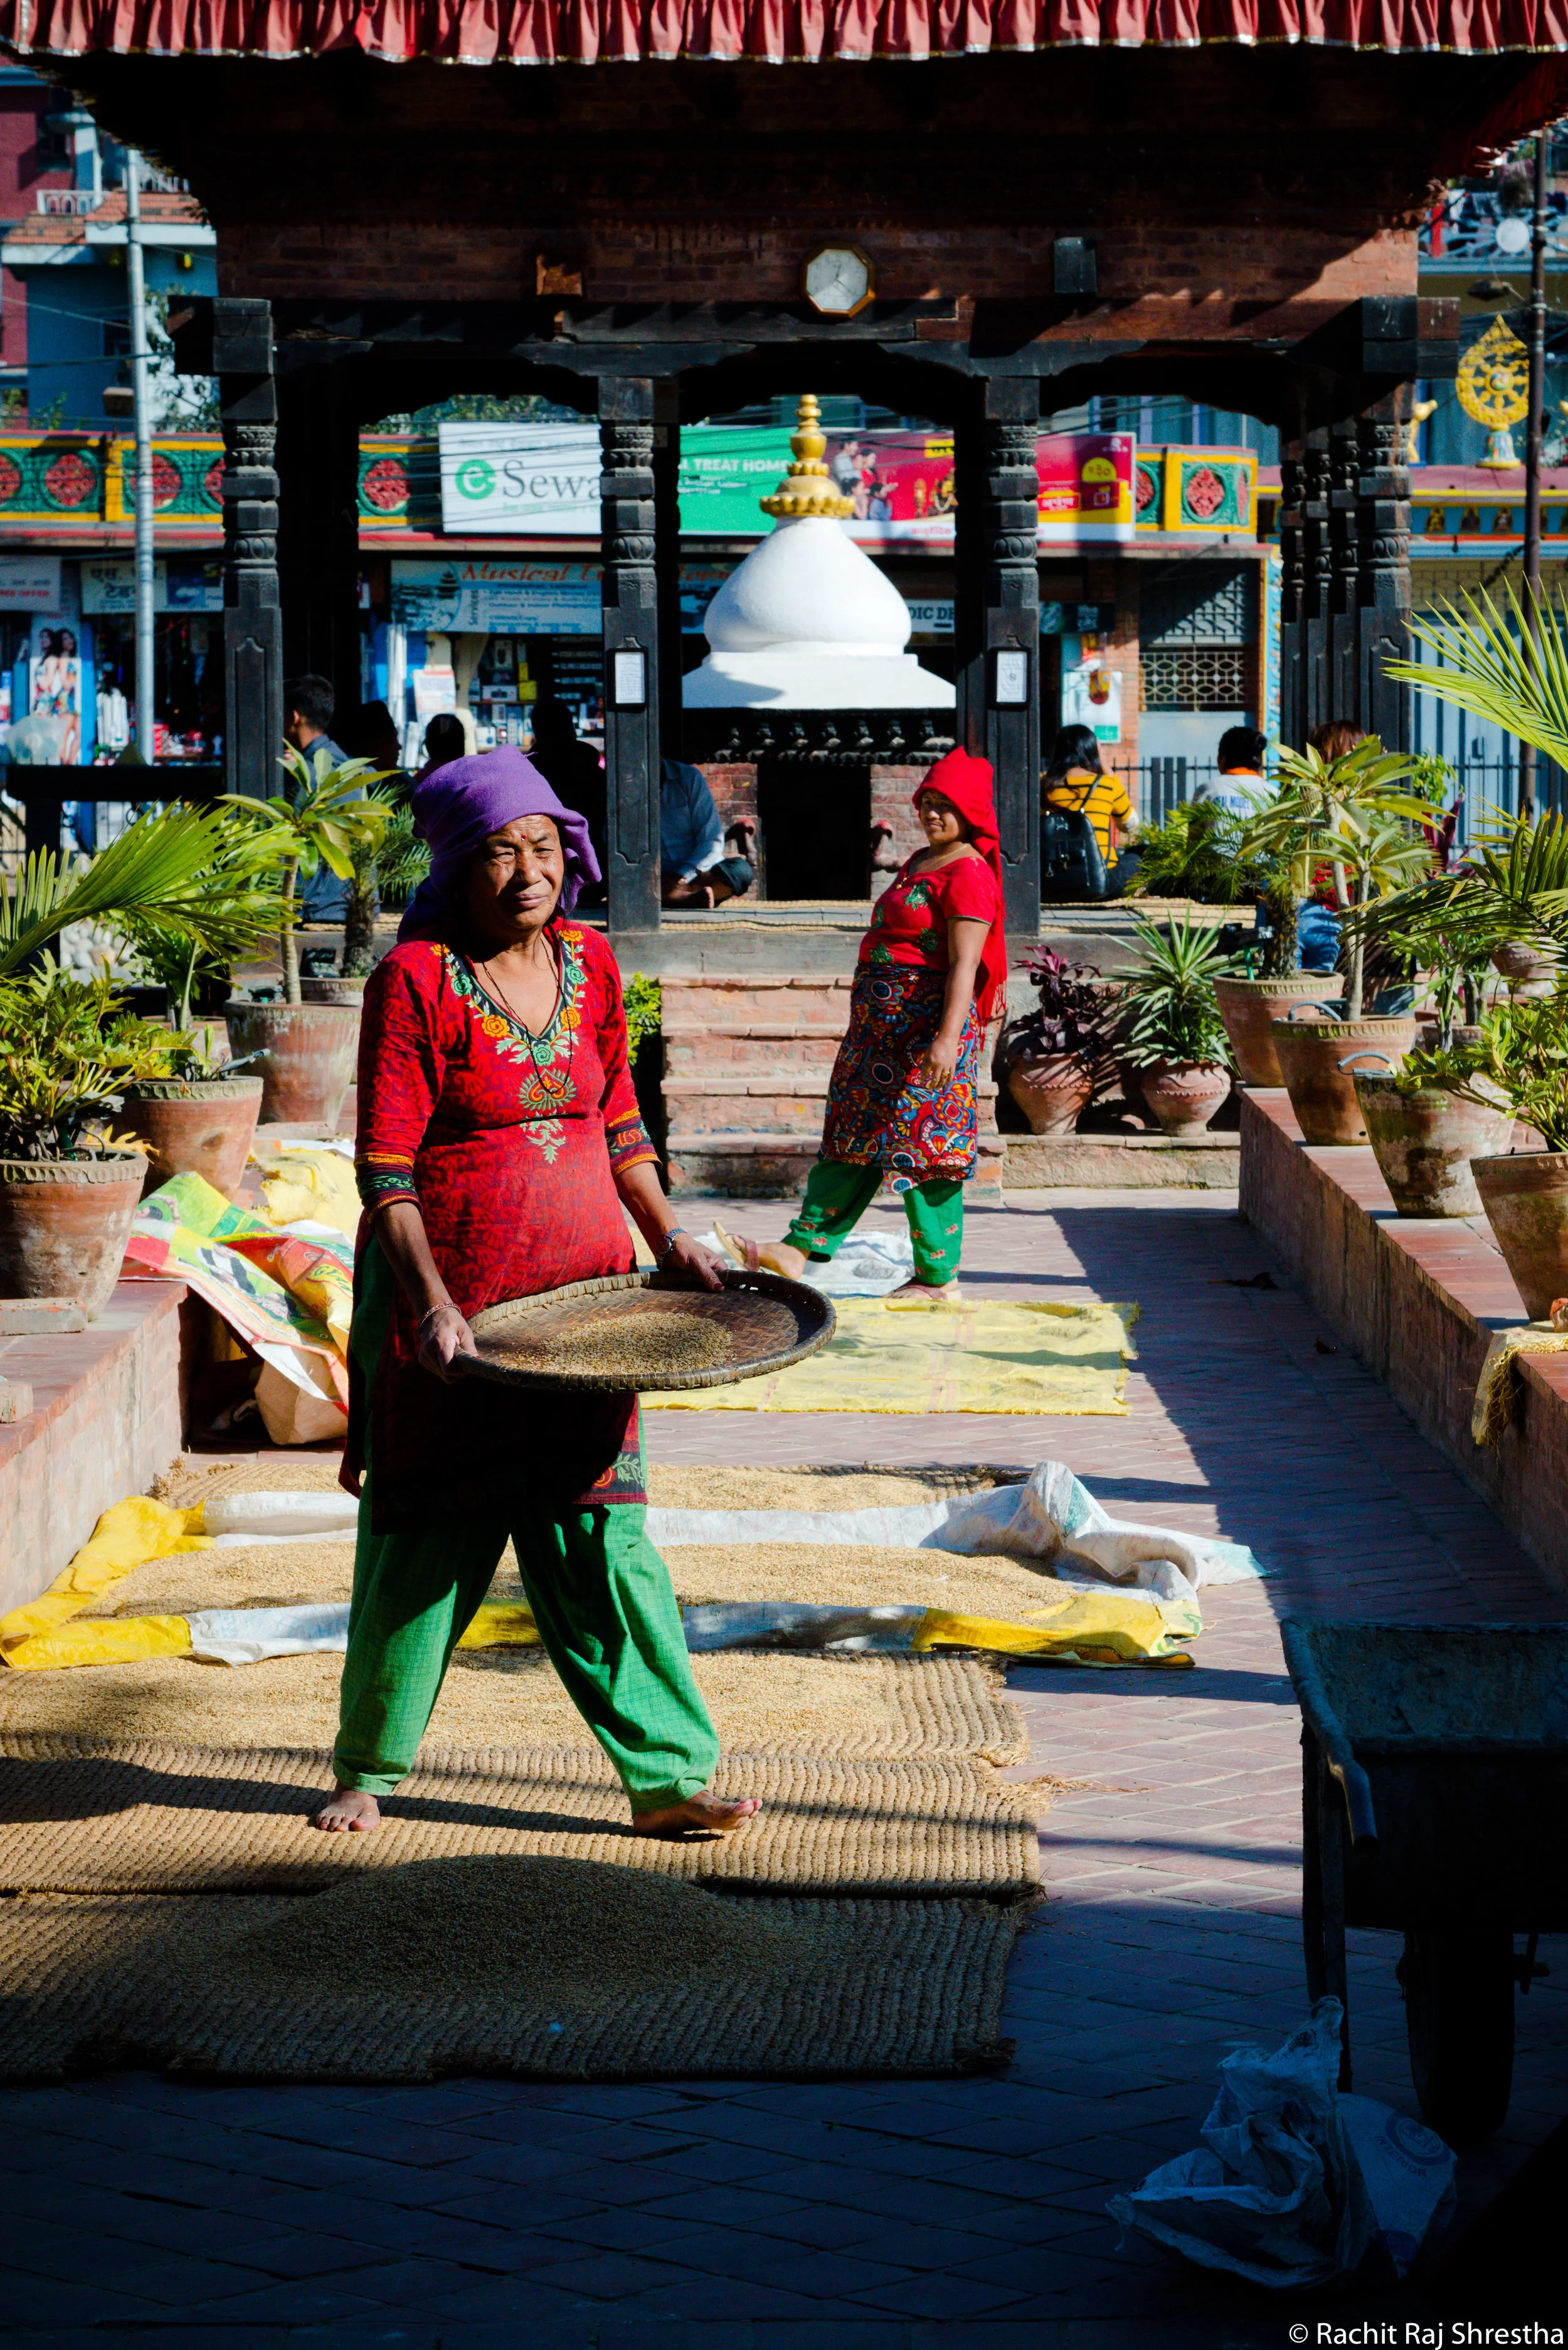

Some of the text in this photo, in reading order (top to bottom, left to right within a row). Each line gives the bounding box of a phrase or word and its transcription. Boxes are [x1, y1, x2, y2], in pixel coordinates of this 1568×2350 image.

[692, 458, 740, 472] TREAT
[461, 562, 571, 581] Musical
[1374, 2134, 1427, 2178] INTERIOR
